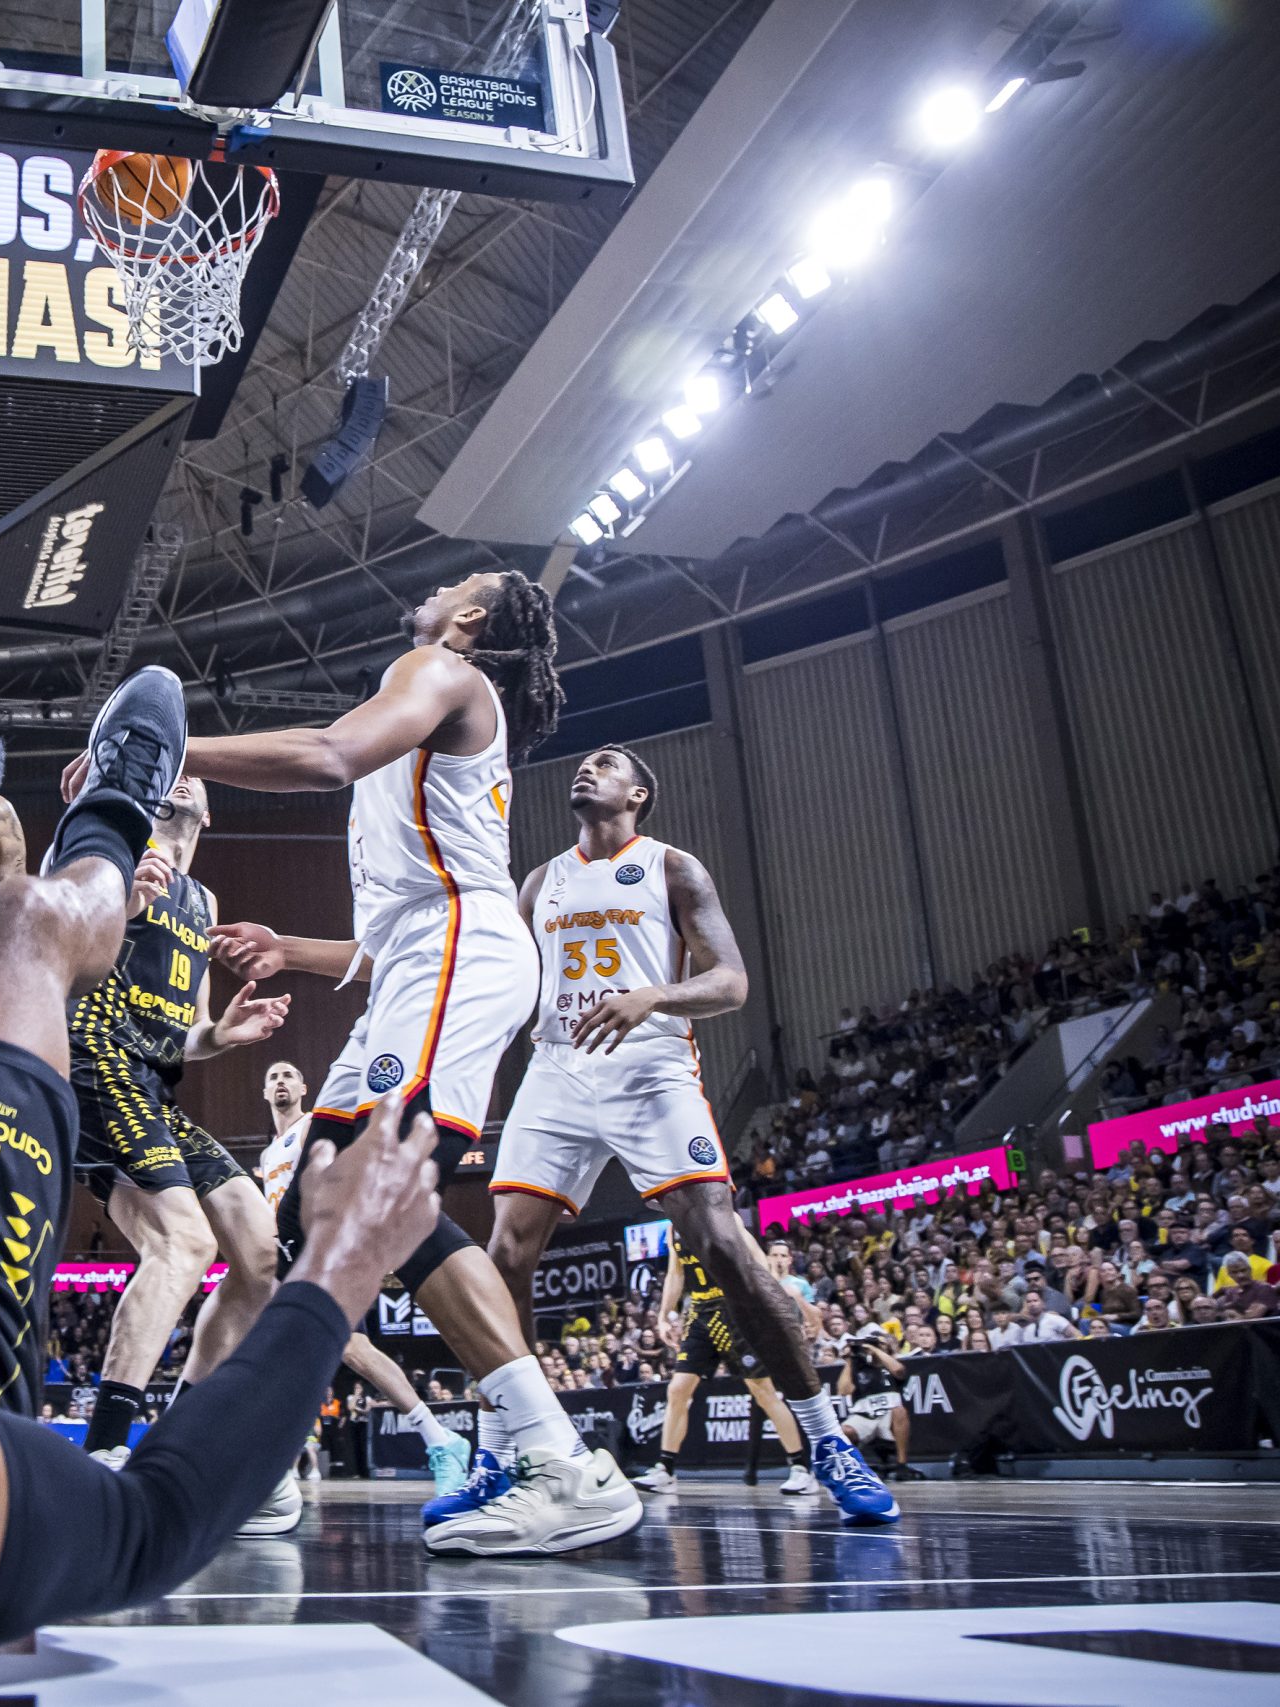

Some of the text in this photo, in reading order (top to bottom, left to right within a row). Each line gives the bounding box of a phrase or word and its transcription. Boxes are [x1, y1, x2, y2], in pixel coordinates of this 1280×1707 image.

[439, 74, 525, 95] BASKETBALL
[440, 84, 537, 107] CHAMPIONS
[441, 95, 494, 112] LEAGUE
[442, 108, 495, 122] SEASON X
[146, 904, 171, 930] LA
[545, 908, 647, 934] GALATASARAY
[169, 948, 192, 992] 19
[562, 937, 622, 981] 35
[128, 984, 196, 1026] tenerif
[459, 1151, 486, 1165] IFE
[531, 1260, 618, 1299] ECORD
[705, 1394, 752, 1418] TERRE
